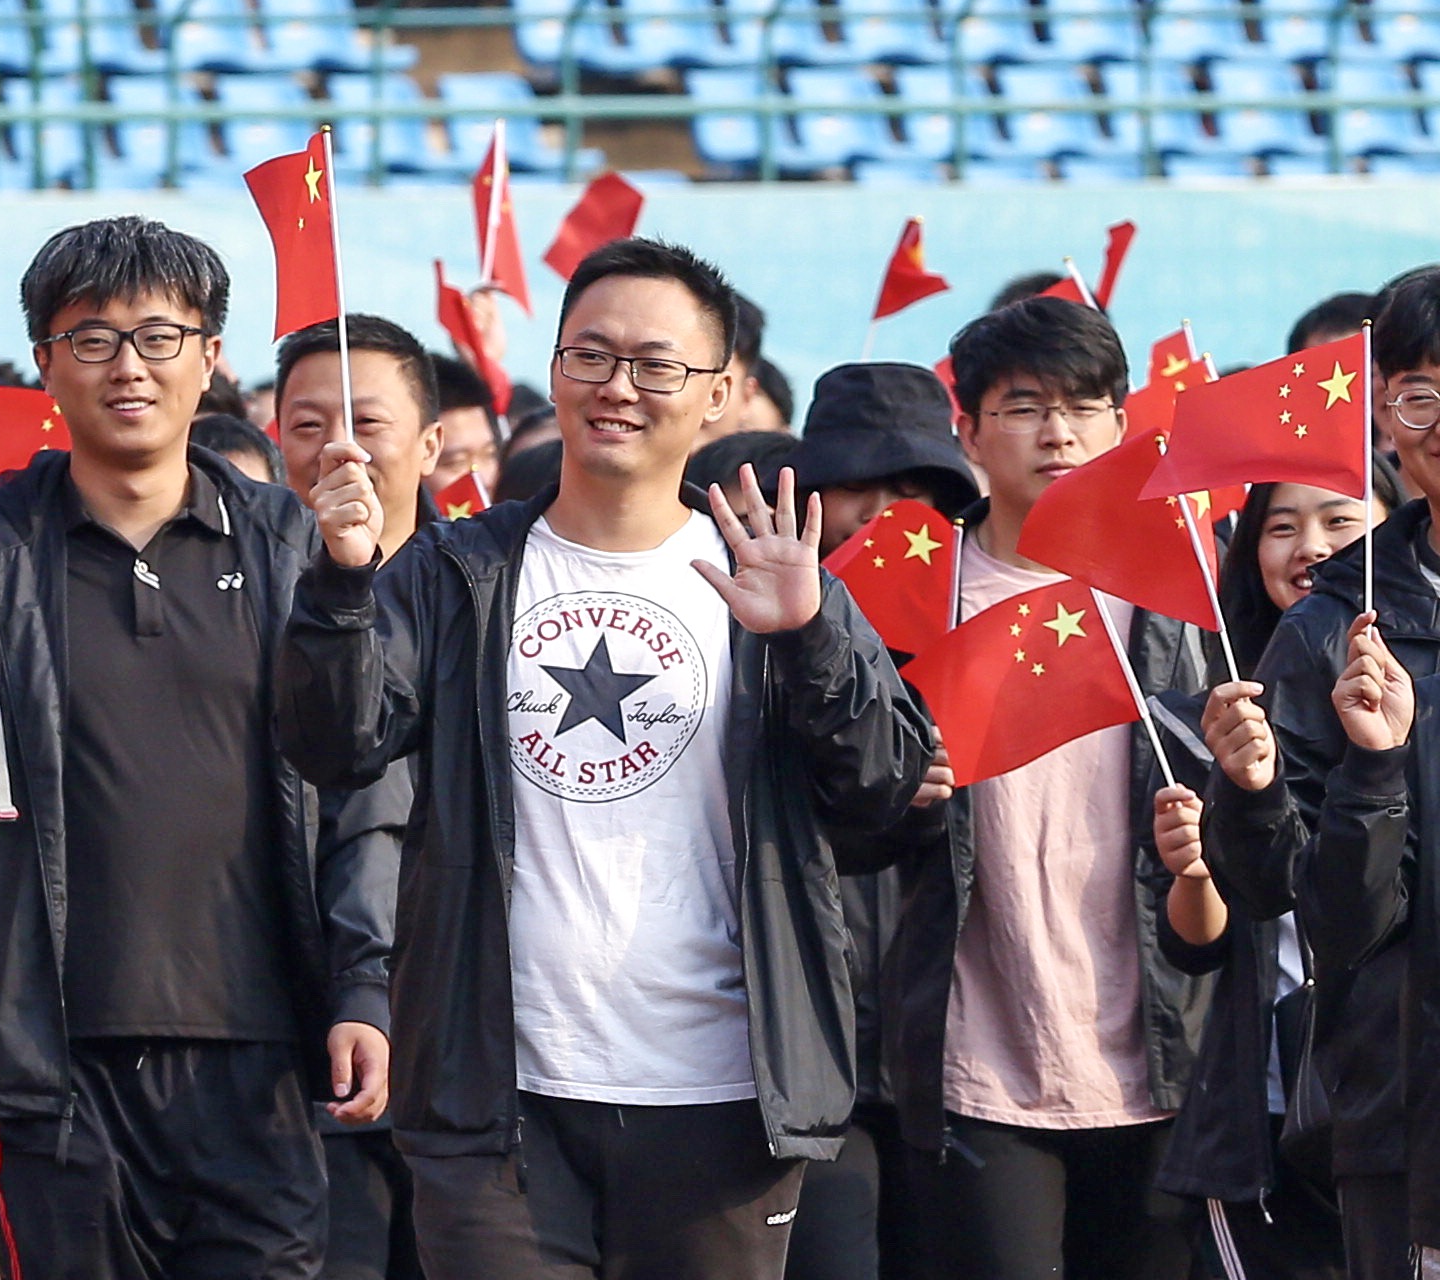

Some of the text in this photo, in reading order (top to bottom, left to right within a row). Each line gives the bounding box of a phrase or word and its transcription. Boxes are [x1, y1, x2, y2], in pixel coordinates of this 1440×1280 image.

[519, 607, 684, 670] CONVERSE
[506, 690, 687, 730] Chuck Taylor
[518, 729, 660, 785] ALL STAR
